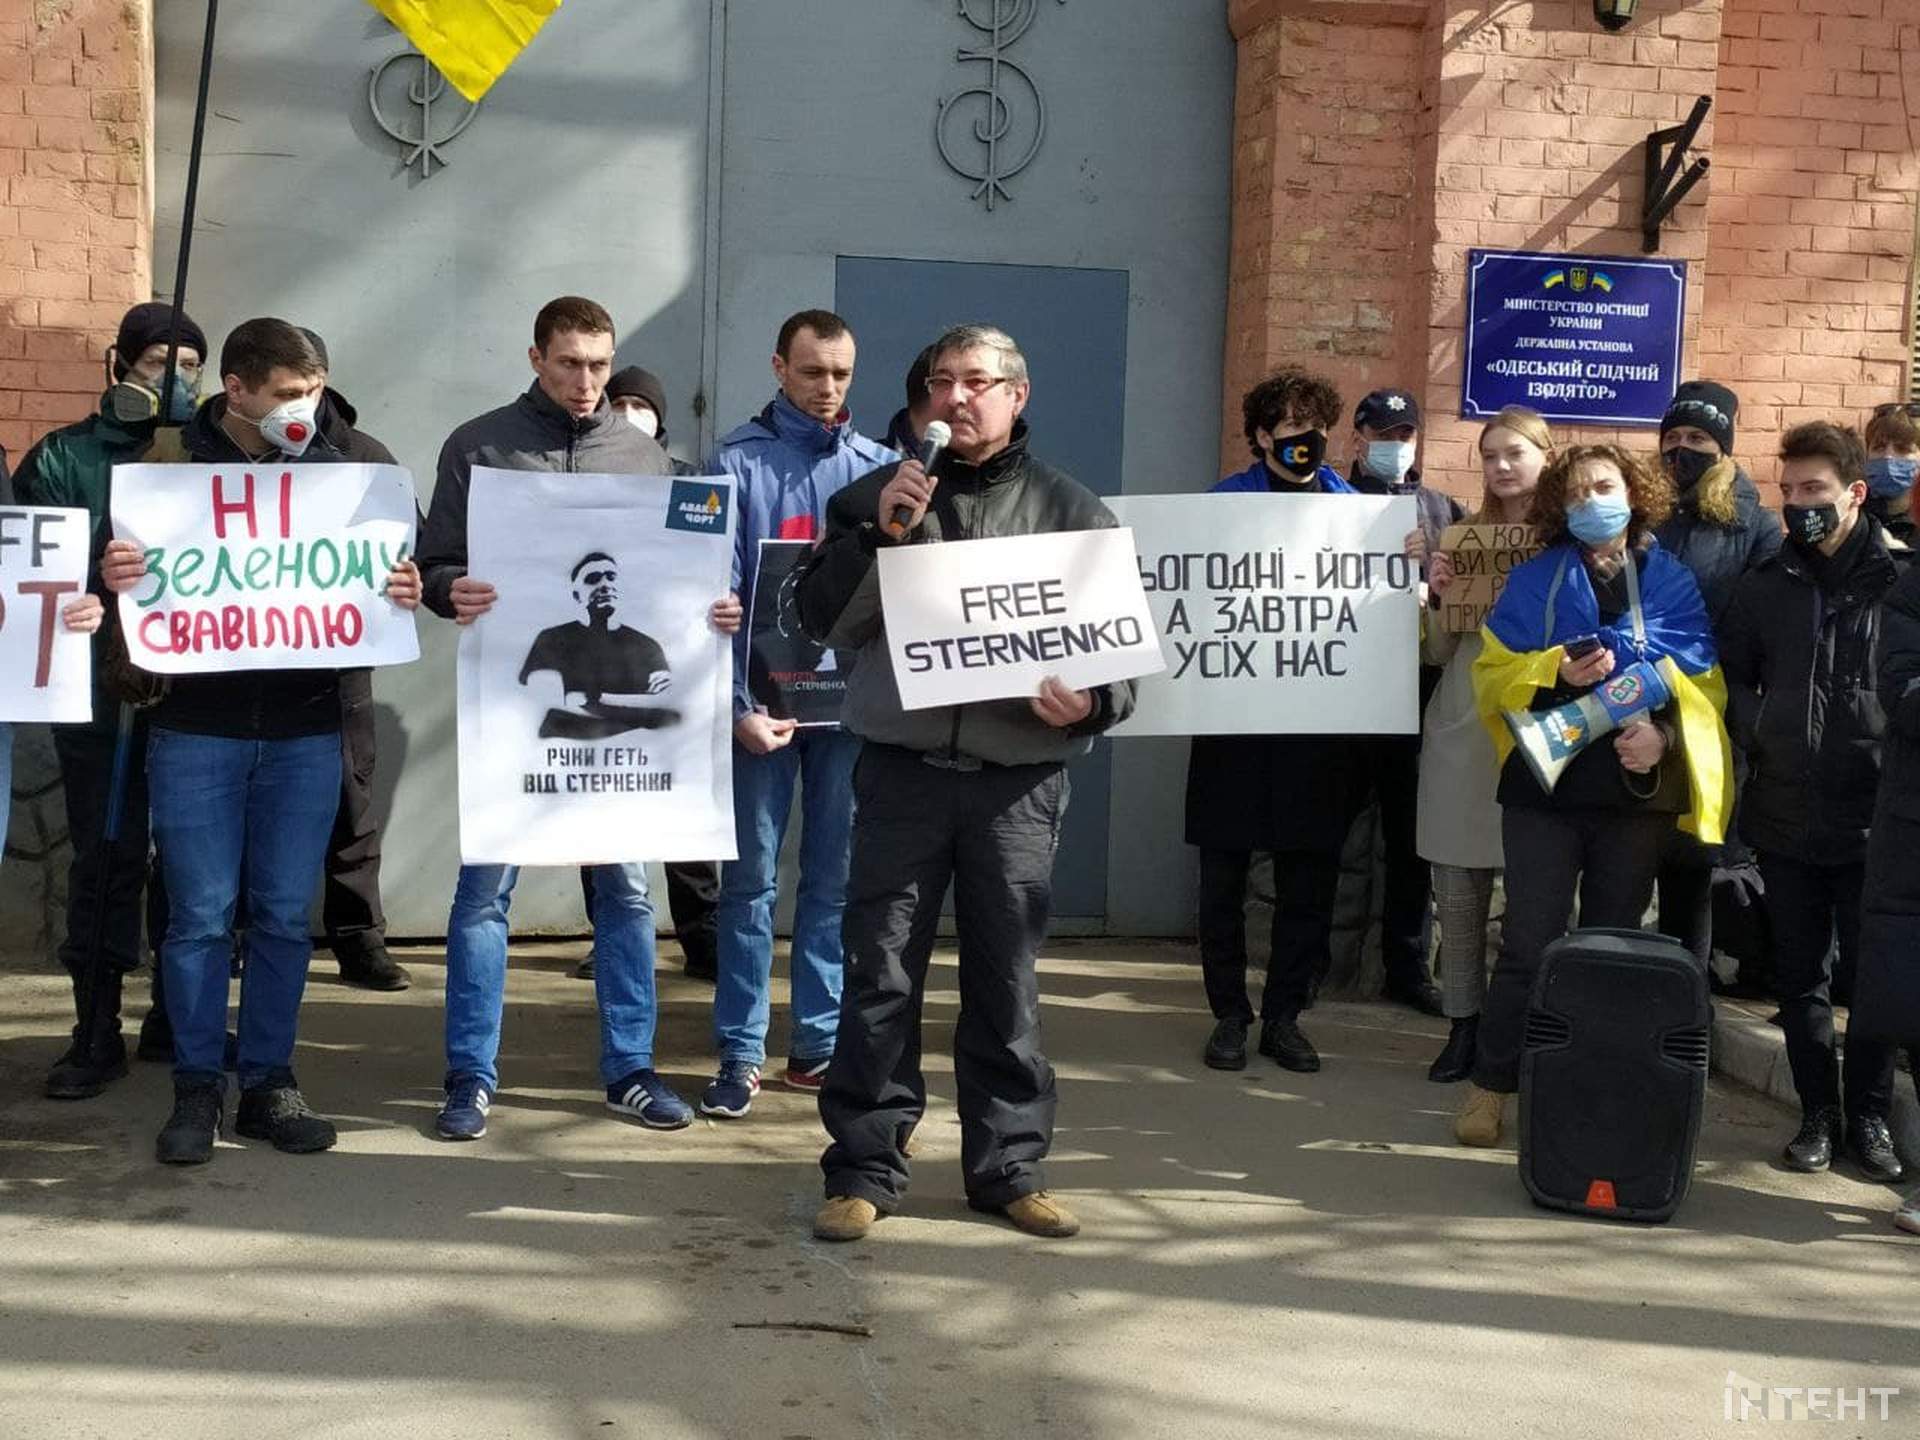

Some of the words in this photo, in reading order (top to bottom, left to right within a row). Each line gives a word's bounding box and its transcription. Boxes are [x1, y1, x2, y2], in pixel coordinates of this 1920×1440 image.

[1503, 298, 1594, 314] МІНІСТЕРСТВО
[1595, 303, 1650, 317] ЮСТИЦІЇ
[1549, 316, 1603, 330] УКРАЇНИ
[1515, 337, 1577, 351] ДЕРЖАВНА
[1577, 340, 1634, 353] УСТАНОВА
[1486, 359, 1583, 378] «ОДЕСЬКИЙ
[1586, 364, 1660, 382] СЛІДЧИЙ
[1527, 381, 1617, 400] ІЗОЛЯТОР»
[211, 471, 293, 539] НІ
[1457, 527, 1487, 549] А
[1137, 551, 1284, 593] ЬОГОДНІ
[1316, 548, 1412, 594] ЙОГО,
[1452, 550, 1485, 575] ВИ
[960, 580, 1066, 623] FREE
[1165, 597, 1191, 635] А
[1214, 597, 1358, 634] ЗАВТРА
[0, 580, 79, 688] T
[137, 603, 364, 655] СВАВІЛЛЮ
[905, 616, 1143, 673] STERNENKO
[1172, 635, 1257, 680] УСІХ
[1276, 640, 1348, 679] НАС
[547, 748, 596, 767] РУКИ
[603, 748, 648, 767] ГЕТЬ
[523, 773, 558, 793] ВІД
